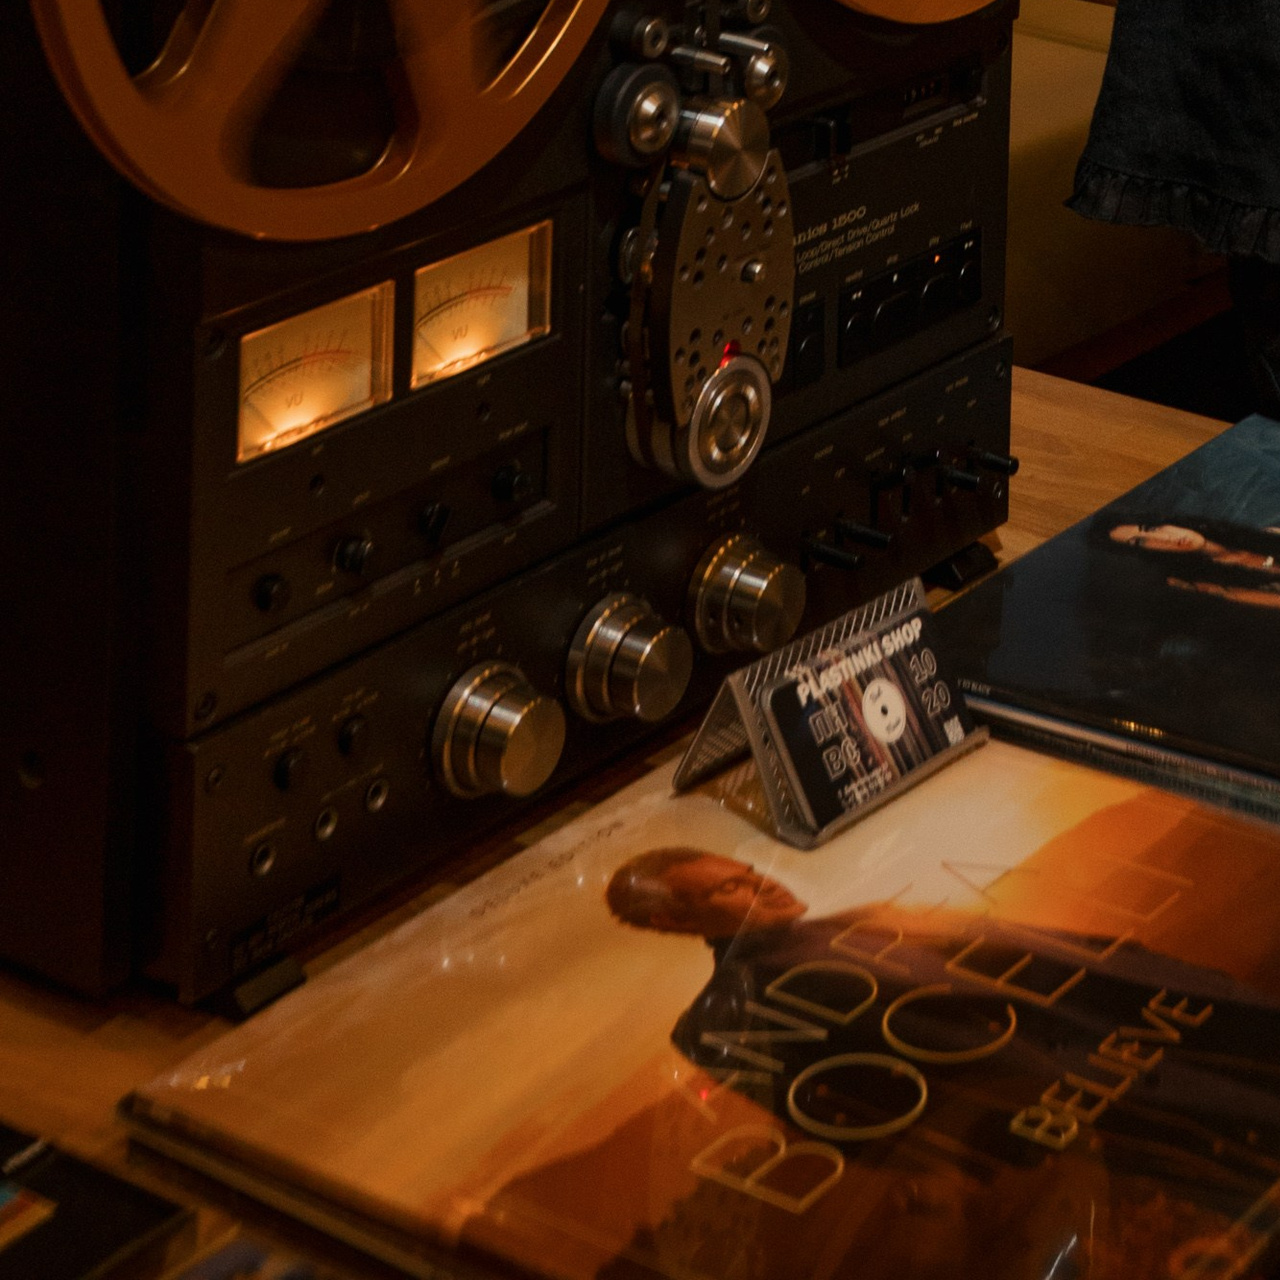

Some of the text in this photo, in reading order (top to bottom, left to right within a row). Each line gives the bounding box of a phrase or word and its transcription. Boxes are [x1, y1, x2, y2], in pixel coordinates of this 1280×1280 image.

[865, 223, 896, 246] Control
[881, 617, 923, 656] SHOP
[910, 647, 937, 685] 10
[921, 680, 951, 718] 20
[1009, 987, 1214, 1150] BELIEVE
